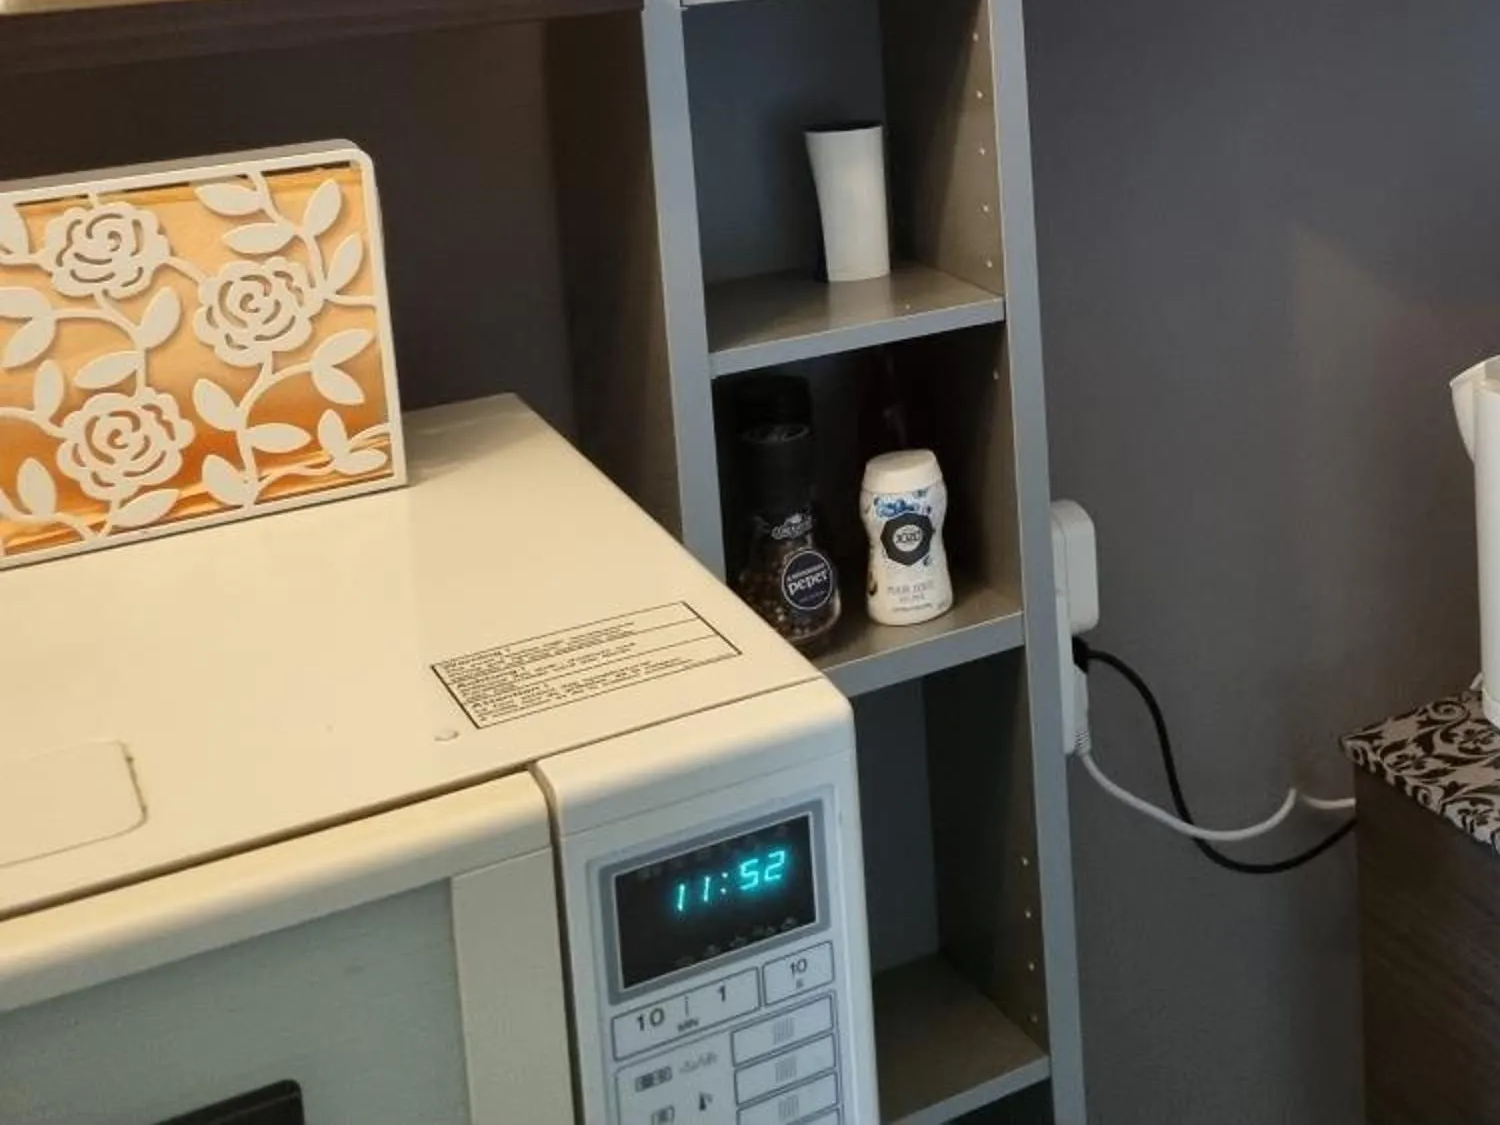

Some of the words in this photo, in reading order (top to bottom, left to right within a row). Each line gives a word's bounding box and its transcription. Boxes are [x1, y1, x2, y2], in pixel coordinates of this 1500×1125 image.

[675, 850, 786, 912] 11:52
[790, 958, 808, 976] 10
[637, 1007, 666, 1031] 10
